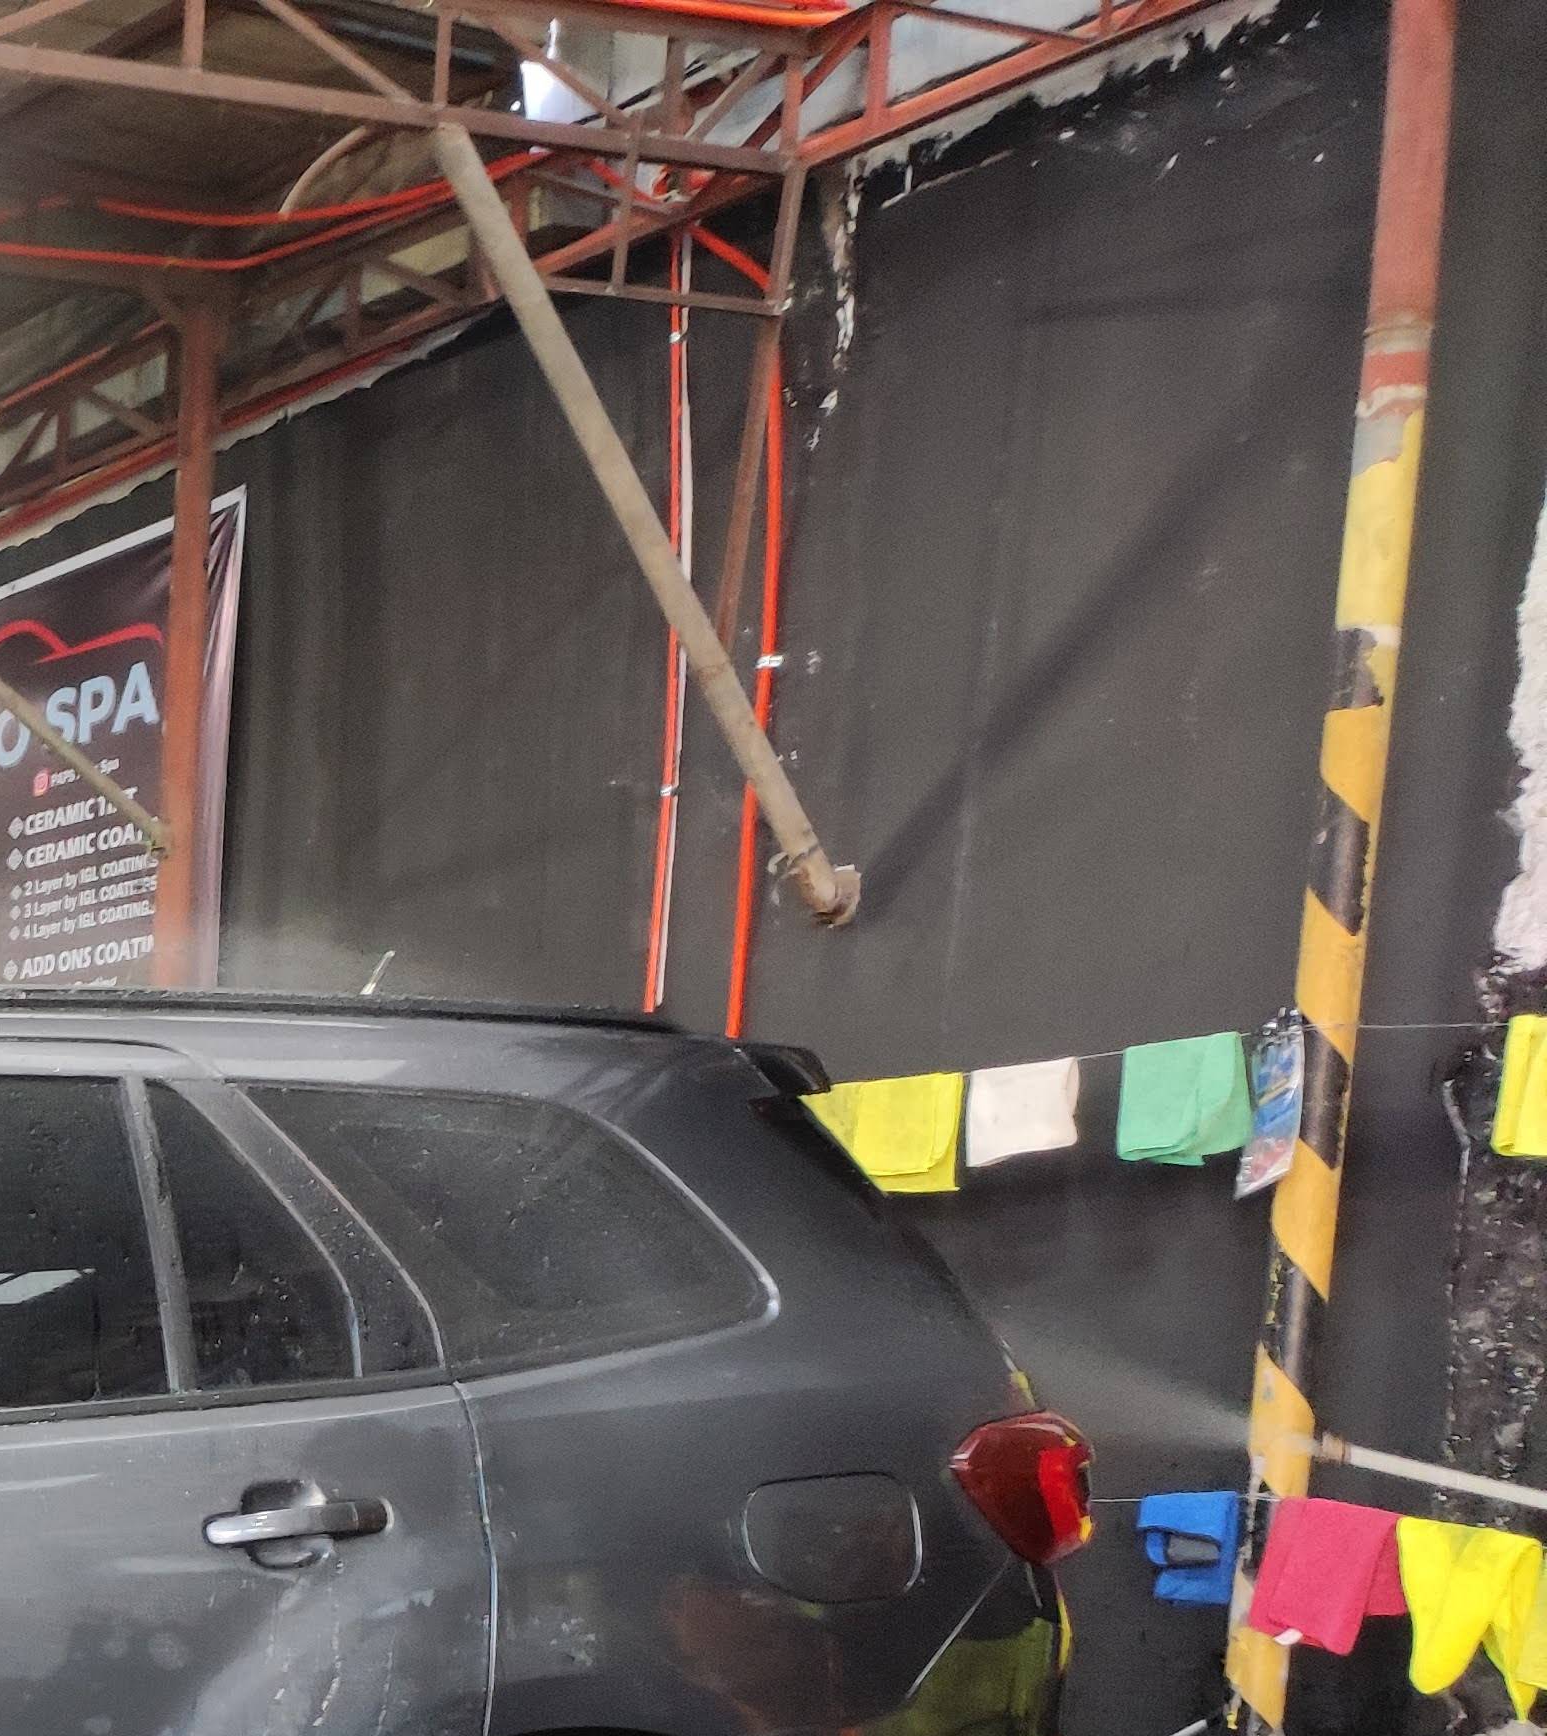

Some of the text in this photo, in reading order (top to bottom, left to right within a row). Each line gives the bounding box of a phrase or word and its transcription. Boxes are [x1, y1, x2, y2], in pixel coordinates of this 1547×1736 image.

[44, 661, 160, 745] SPA
[24, 798, 97, 836] CERAMIC
[24, 833, 97, 869] CERAMIC
[25, 881, 33, 897] 2
[20, 953, 55, 979] ADD
[58, 945, 92, 972] ONS
